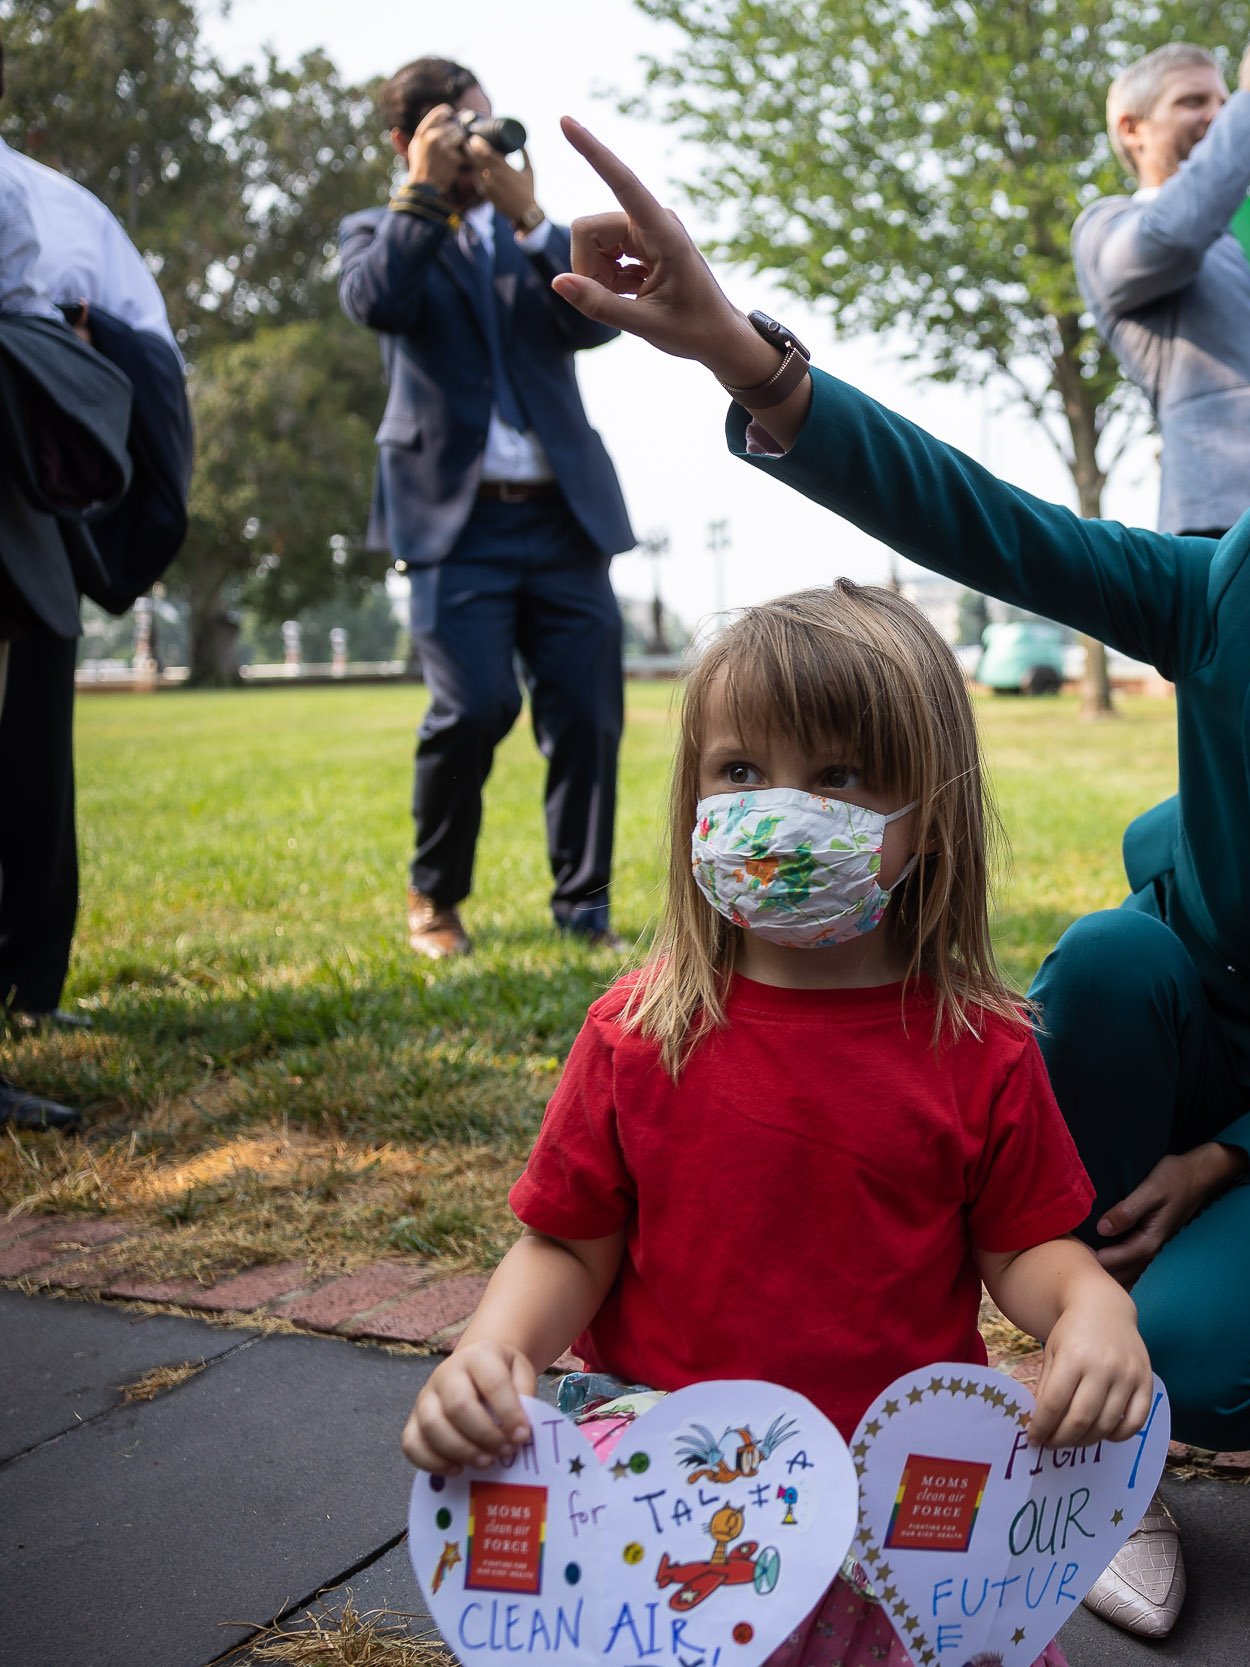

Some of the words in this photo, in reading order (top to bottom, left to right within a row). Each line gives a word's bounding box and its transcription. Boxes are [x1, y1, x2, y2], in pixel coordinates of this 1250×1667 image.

[921, 1475, 968, 1489] MOMS
[916, 1488, 945, 1502] clean
[947, 1491, 966, 1503] air
[486, 1504, 531, 1519] MOMS
[567, 1490, 608, 1537] for
[912, 1504, 962, 1518] FORCE
[1009, 1488, 1095, 1555] OUR
[483, 1538, 529, 1553] FORCE
[458, 1597, 583, 1653] CLEAN
